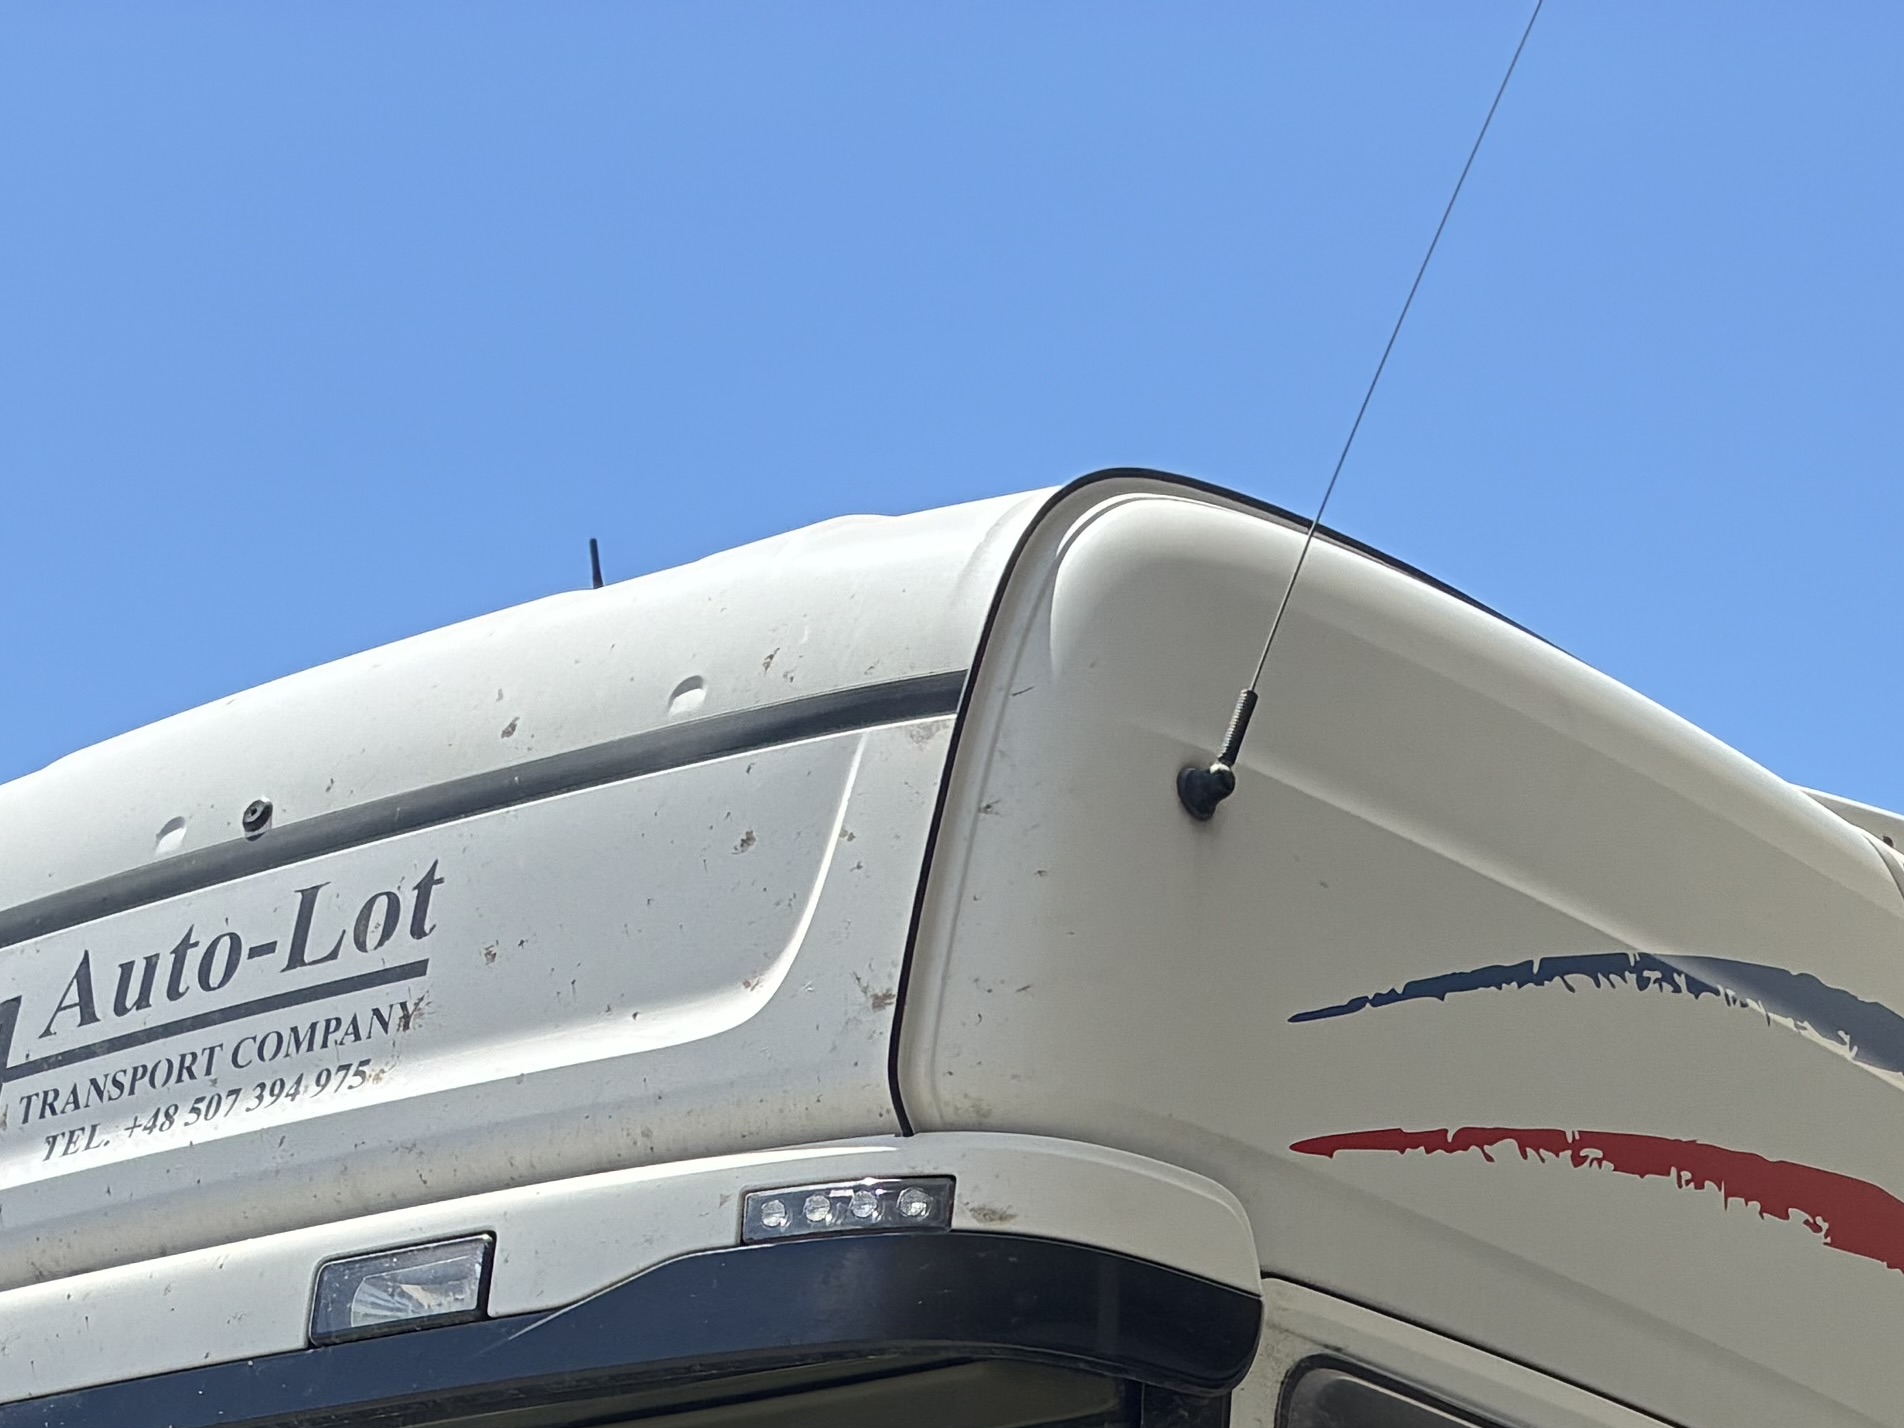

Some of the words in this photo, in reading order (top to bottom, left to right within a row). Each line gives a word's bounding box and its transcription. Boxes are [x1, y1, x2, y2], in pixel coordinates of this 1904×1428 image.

[39, 859, 444, 1038] Auto-Lot
[19, 1044, 224, 1125] TRANSPORT
[232, 997, 425, 1067] COMPANY
[43, 1127, 110, 1161] TEL.
[124, 1104, 178, 1139] +48
[184, 1088, 240, 1126] 507
[245, 1074, 302, 1112] 394
[313, 1058, 374, 1097] 975
